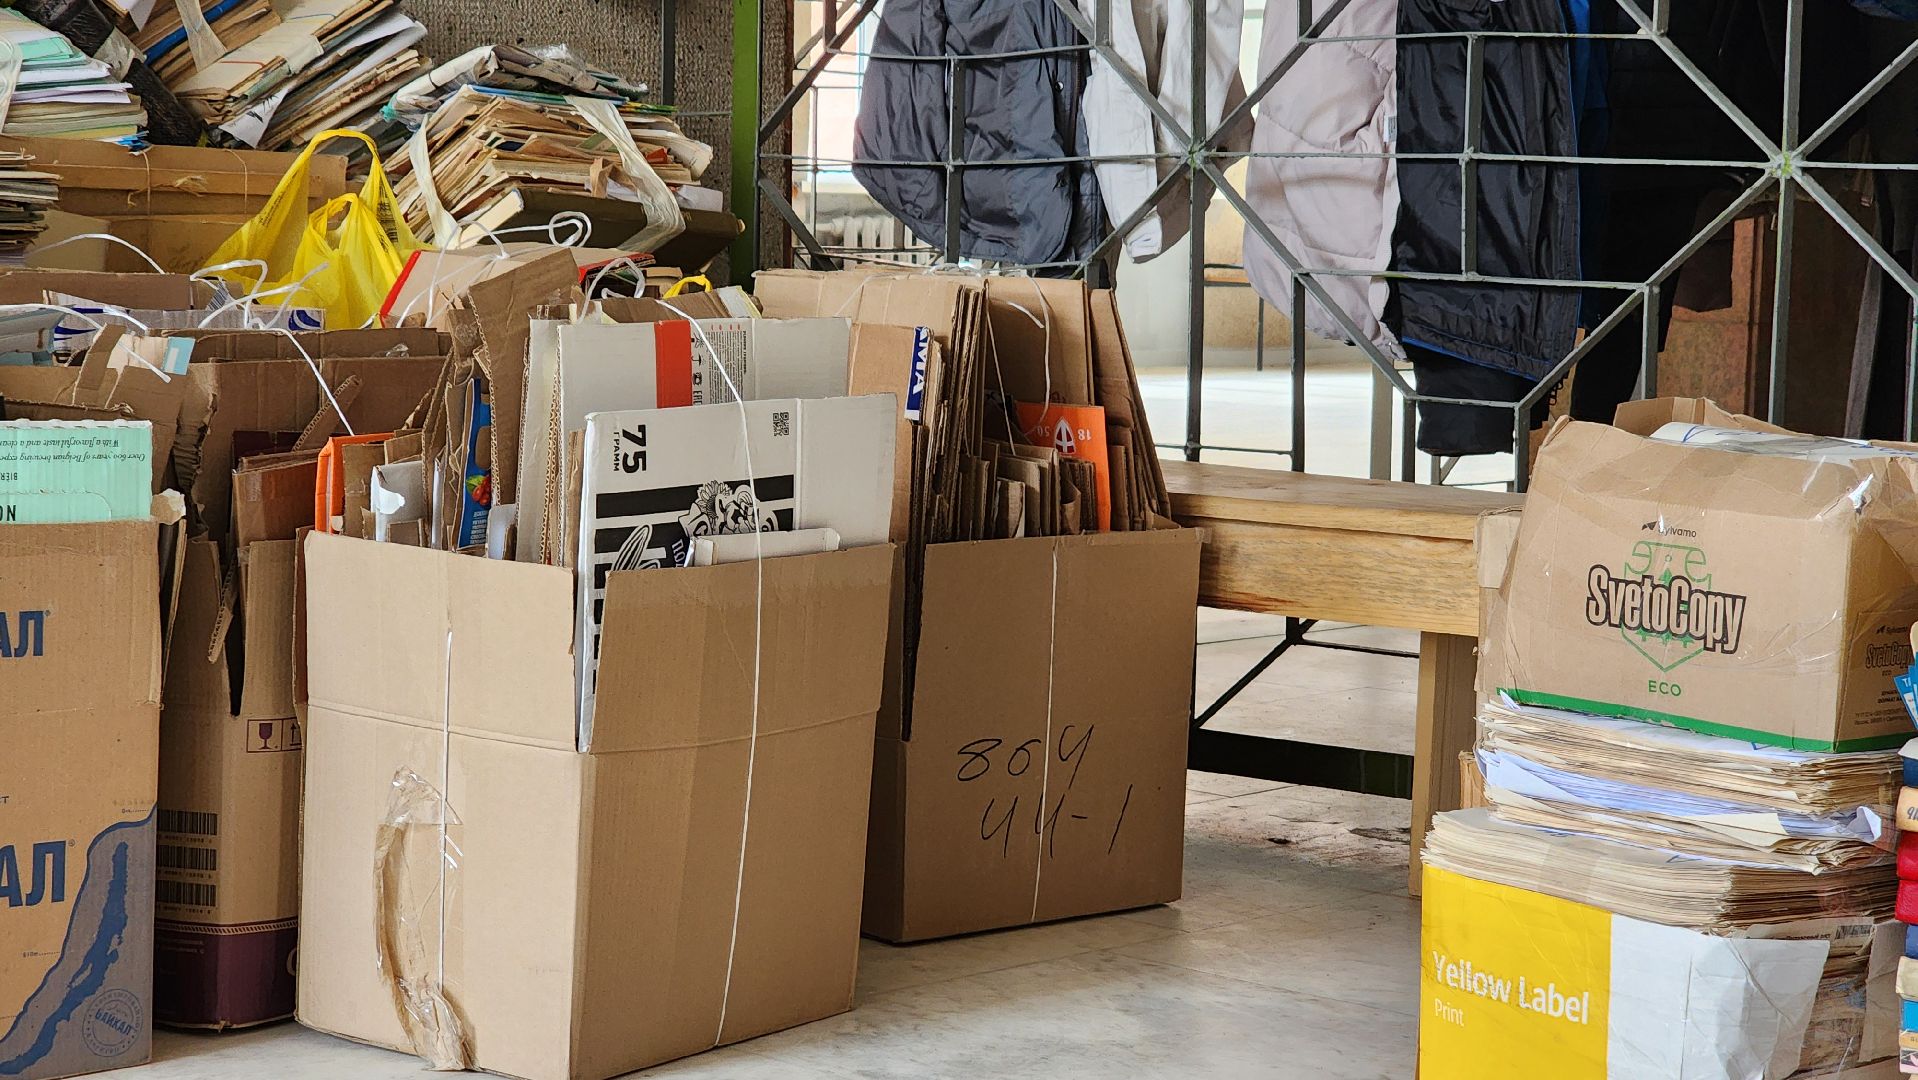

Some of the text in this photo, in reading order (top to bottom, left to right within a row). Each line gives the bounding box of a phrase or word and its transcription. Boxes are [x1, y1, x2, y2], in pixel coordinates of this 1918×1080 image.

[1077, 428, 1092, 441] 18
[26, 440, 41, 448] and
[622, 424, 647, 474] 75
[20, 452, 51, 463] brewing
[53, 452, 81, 462] Belgian
[1586, 564, 1747, 654] SvetoCopy
[1648, 680, 1682, 697] ECO
[1432, 950, 1589, 1025] Yellow Label
[1434, 998, 1465, 1027] Print
